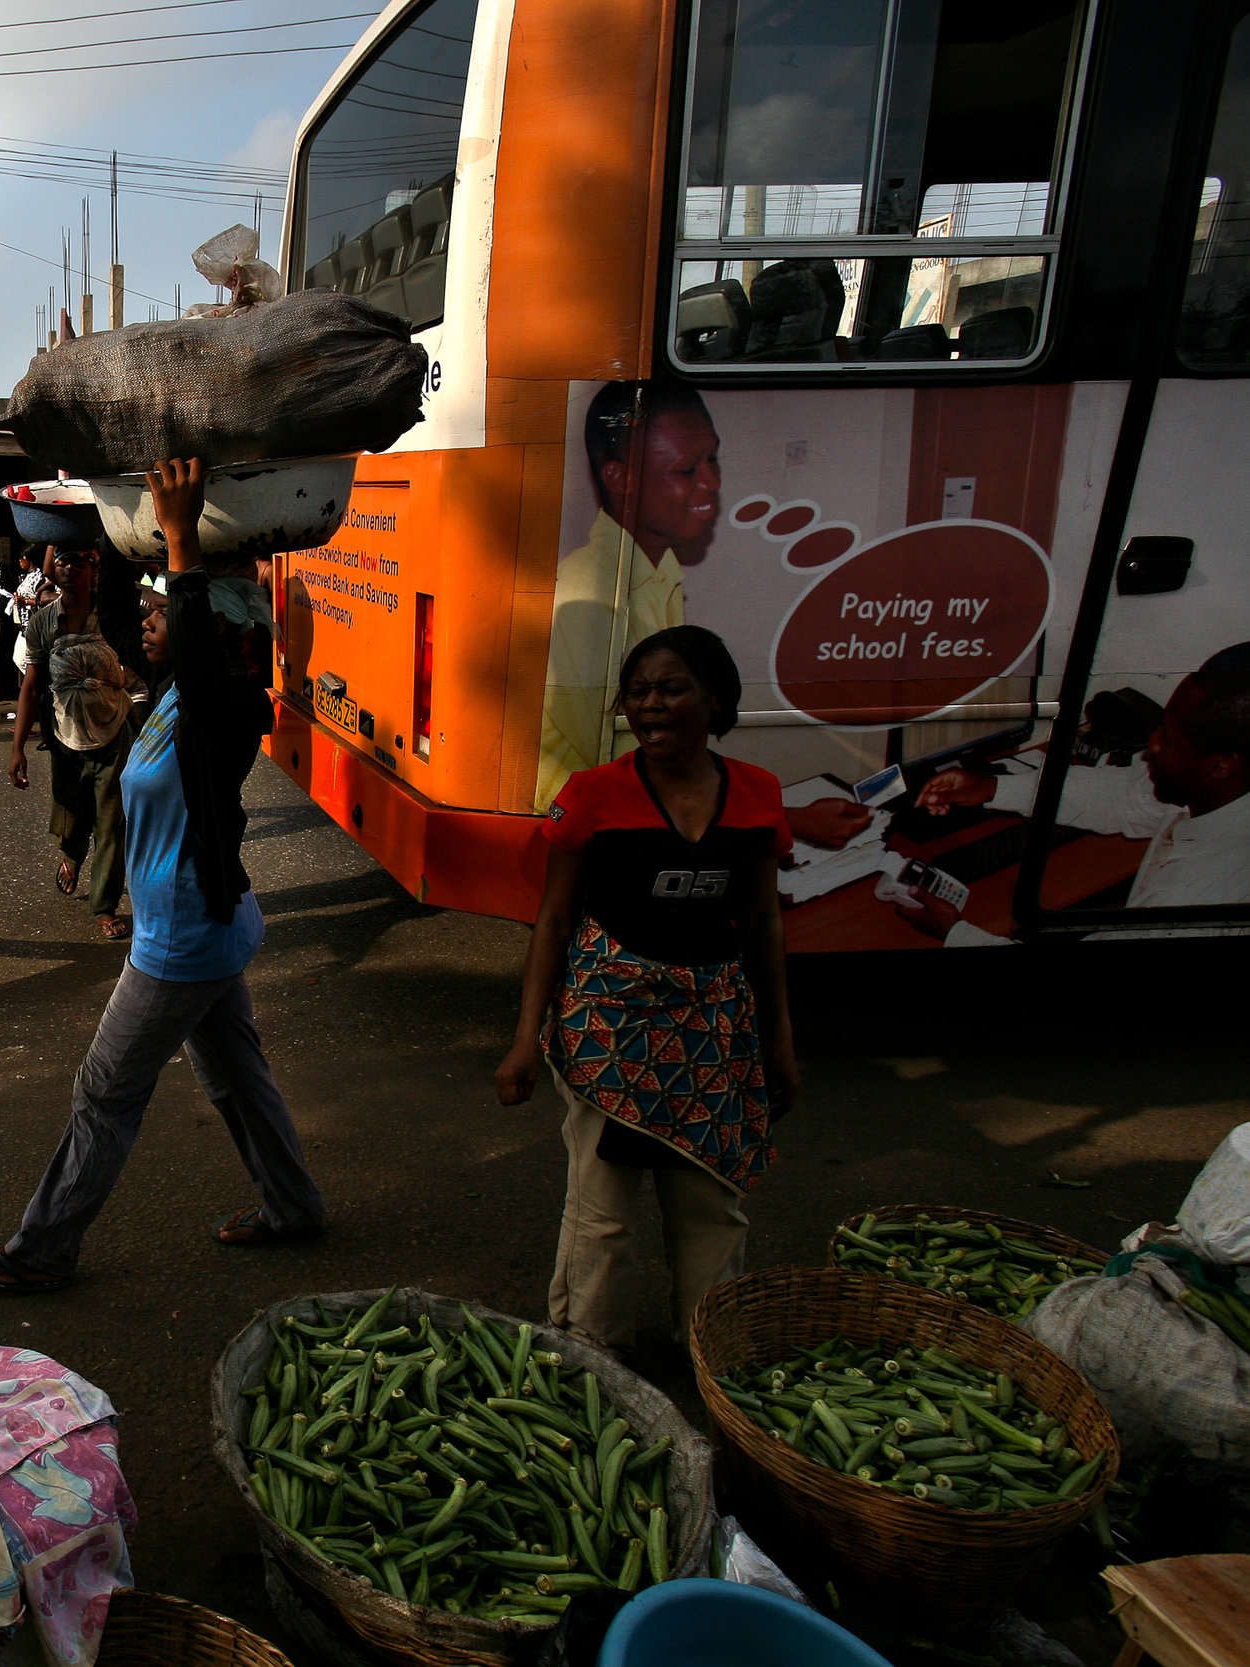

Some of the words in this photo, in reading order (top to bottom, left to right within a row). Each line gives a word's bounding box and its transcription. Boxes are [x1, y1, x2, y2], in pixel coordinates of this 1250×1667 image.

[350, 508, 397, 532] Convenient
[318, 546, 342, 565] e-zwich
[343, 550, 359, 568] card
[360, 551, 378, 572] Now
[379, 553, 399, 576] from
[305, 571, 332, 590] approved
[332, 574, 349, 595] Bank
[350, 581, 365, 599] and
[365, 582, 399, 613] Savings
[322, 598, 354, 630] Company.
[840, 592, 934, 627] Paying
[946, 597, 990, 624] my
[816, 632, 907, 660] school
[921, 631, 993, 659] fees.
